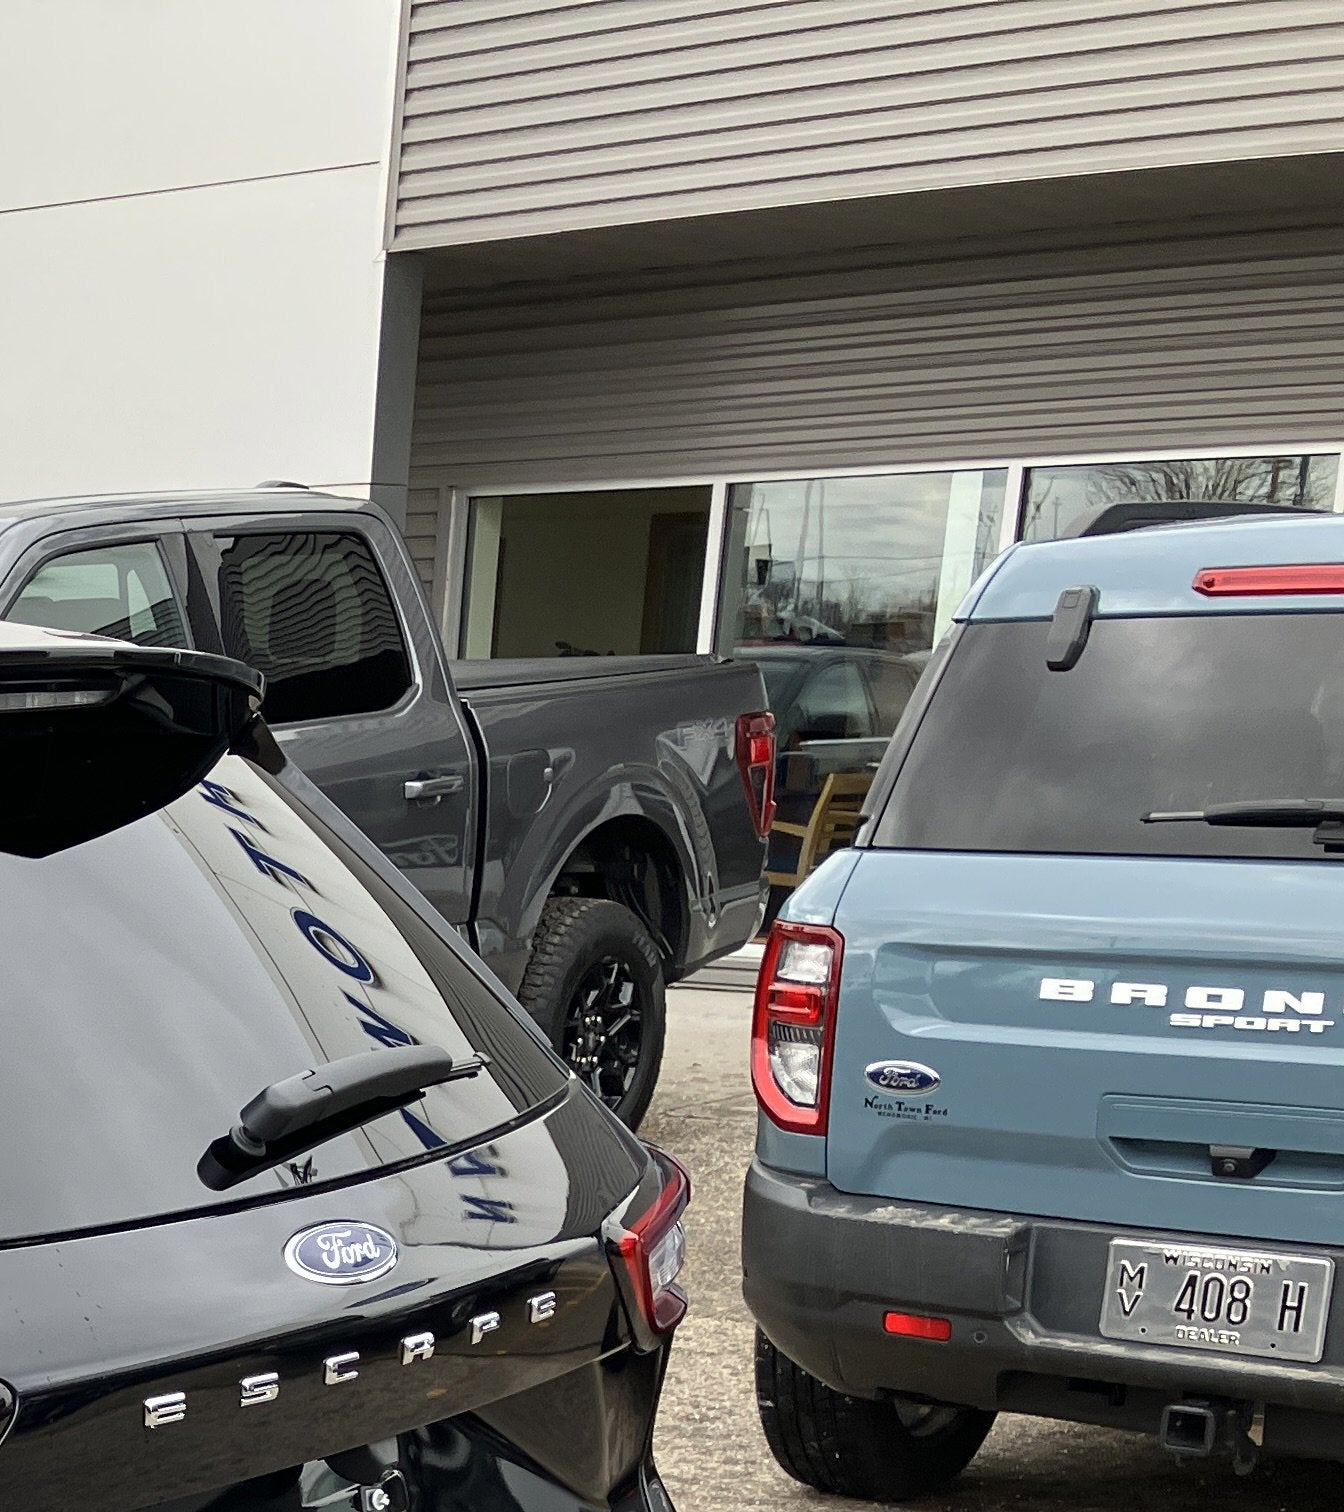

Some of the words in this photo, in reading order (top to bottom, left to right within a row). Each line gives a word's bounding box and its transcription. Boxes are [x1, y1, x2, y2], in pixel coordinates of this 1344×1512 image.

[1038, 977, 1344, 1015] BRON
[1169, 1013, 1336, 1033] SPORT
[878, 1066, 921, 1089] Ford
[864, 1095, 894, 1111] North
[895, 1101, 923, 1114] Town
[924, 1104, 949, 1117] Ford
[316, 1229, 381, 1270] Ford
[1162, 1248, 1273, 1275] WISCONSIN
[1173, 1270, 1255, 1326] 408
[1277, 1279, 1310, 1334] H
[1174, 1324, 1241, 1346] DEALER
[142, 1289, 558, 1429] ESCAPE
